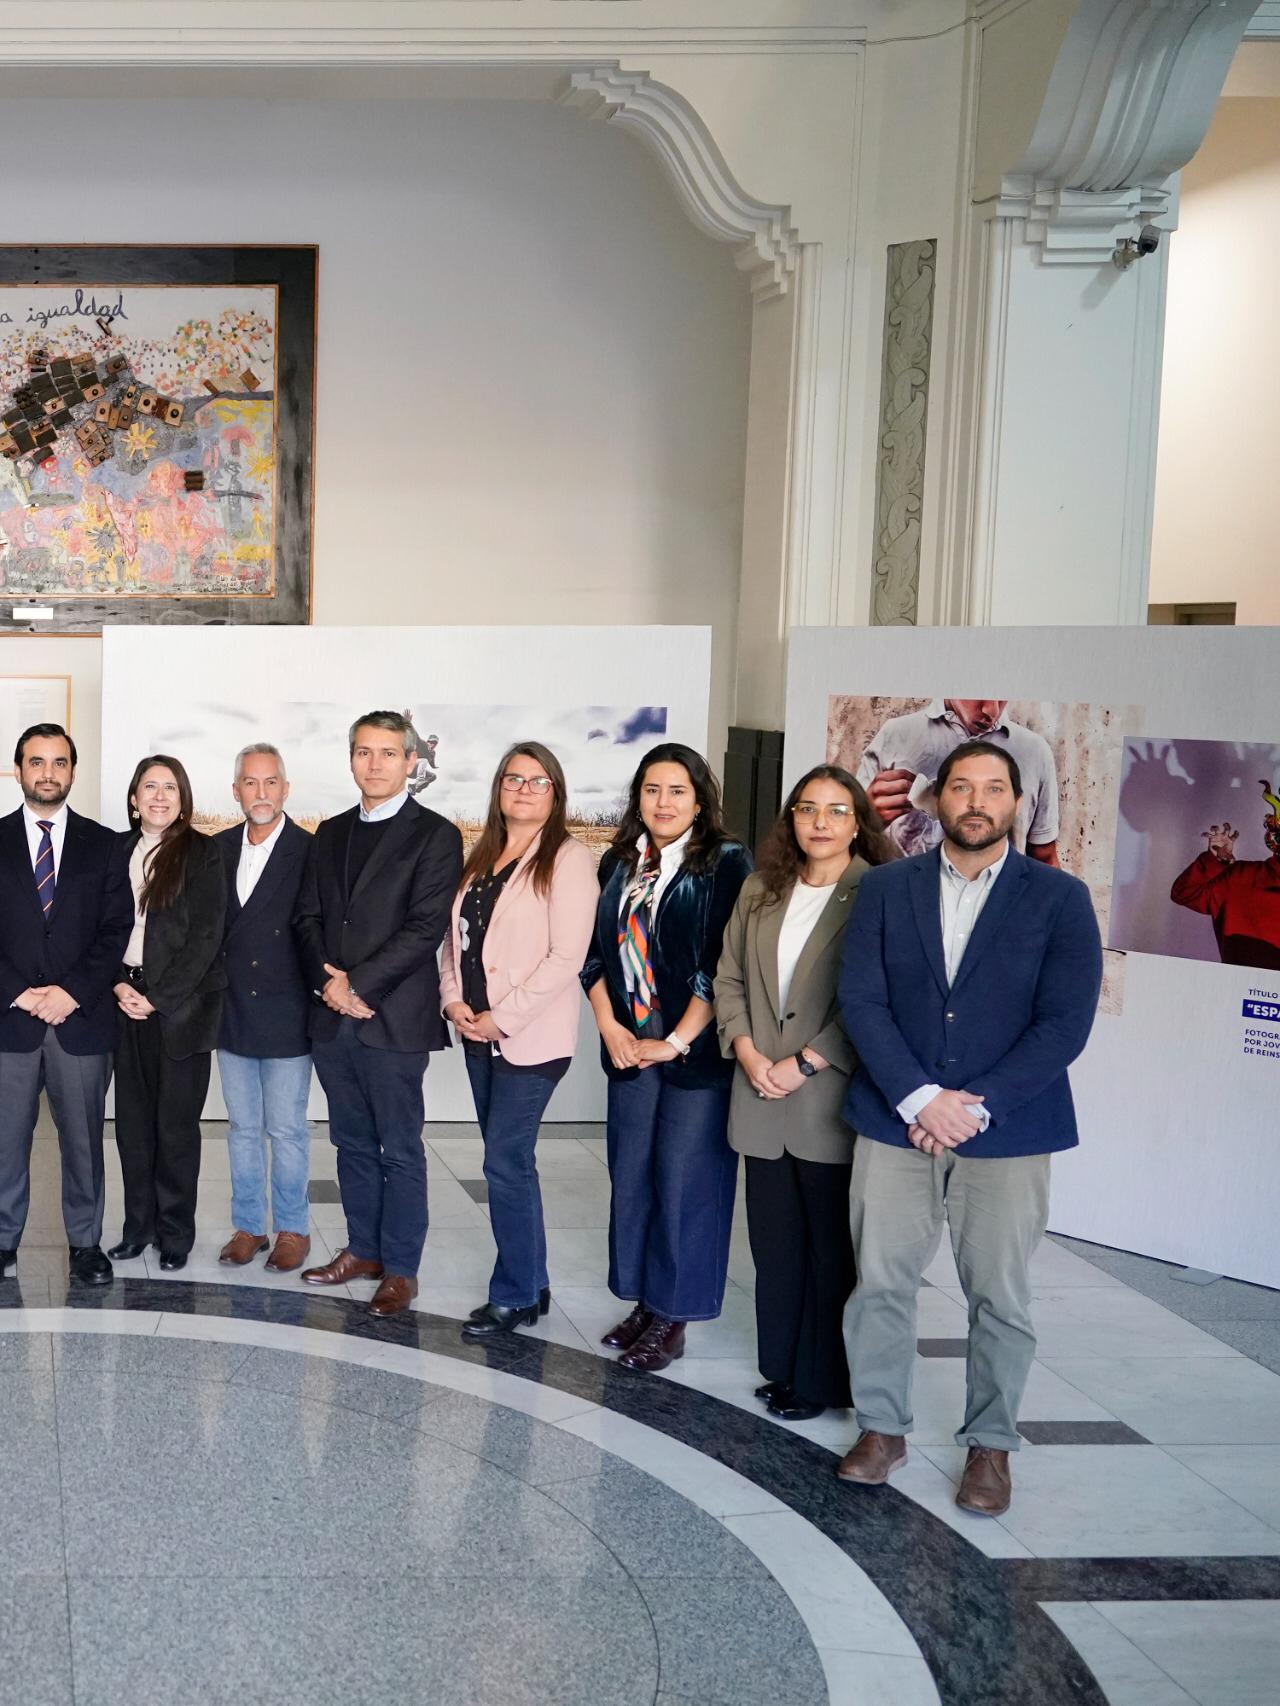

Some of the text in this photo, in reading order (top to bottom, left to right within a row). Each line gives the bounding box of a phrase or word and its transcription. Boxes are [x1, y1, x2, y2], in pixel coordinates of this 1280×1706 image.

[26, 289, 128, 328] igualdad
[1249, 987, 1279, 999] TÍTULO
[1244, 1038, 1261, 1047] POR
[1243, 1047, 1255, 1055] DE
